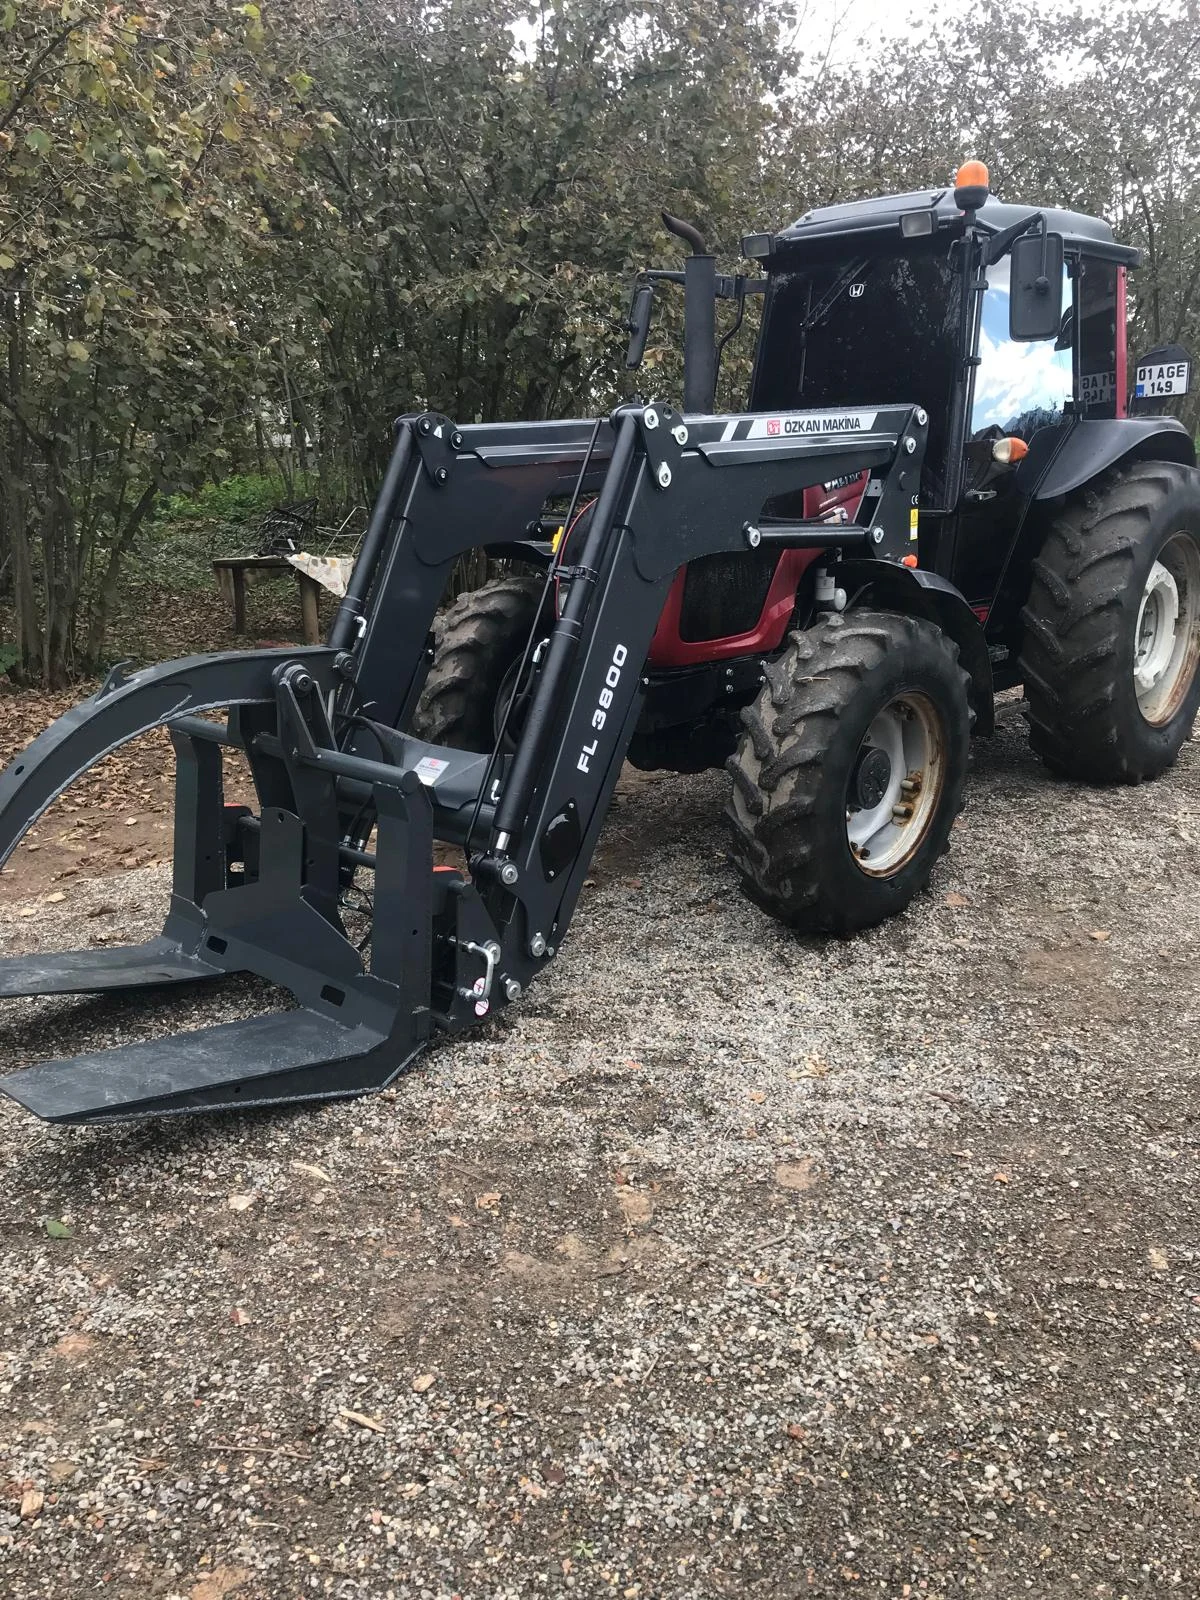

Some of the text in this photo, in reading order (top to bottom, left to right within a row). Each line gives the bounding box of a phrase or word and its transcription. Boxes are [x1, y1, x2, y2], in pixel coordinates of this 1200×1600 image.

[1138, 364, 1186, 381] 01 AGE
[1150, 381, 1173, 394] 149
[784, 418, 820, 433] ÖZKAN
[823, 416, 861, 431] MAKİNA
[576, 643, 628, 773] FL 3800
